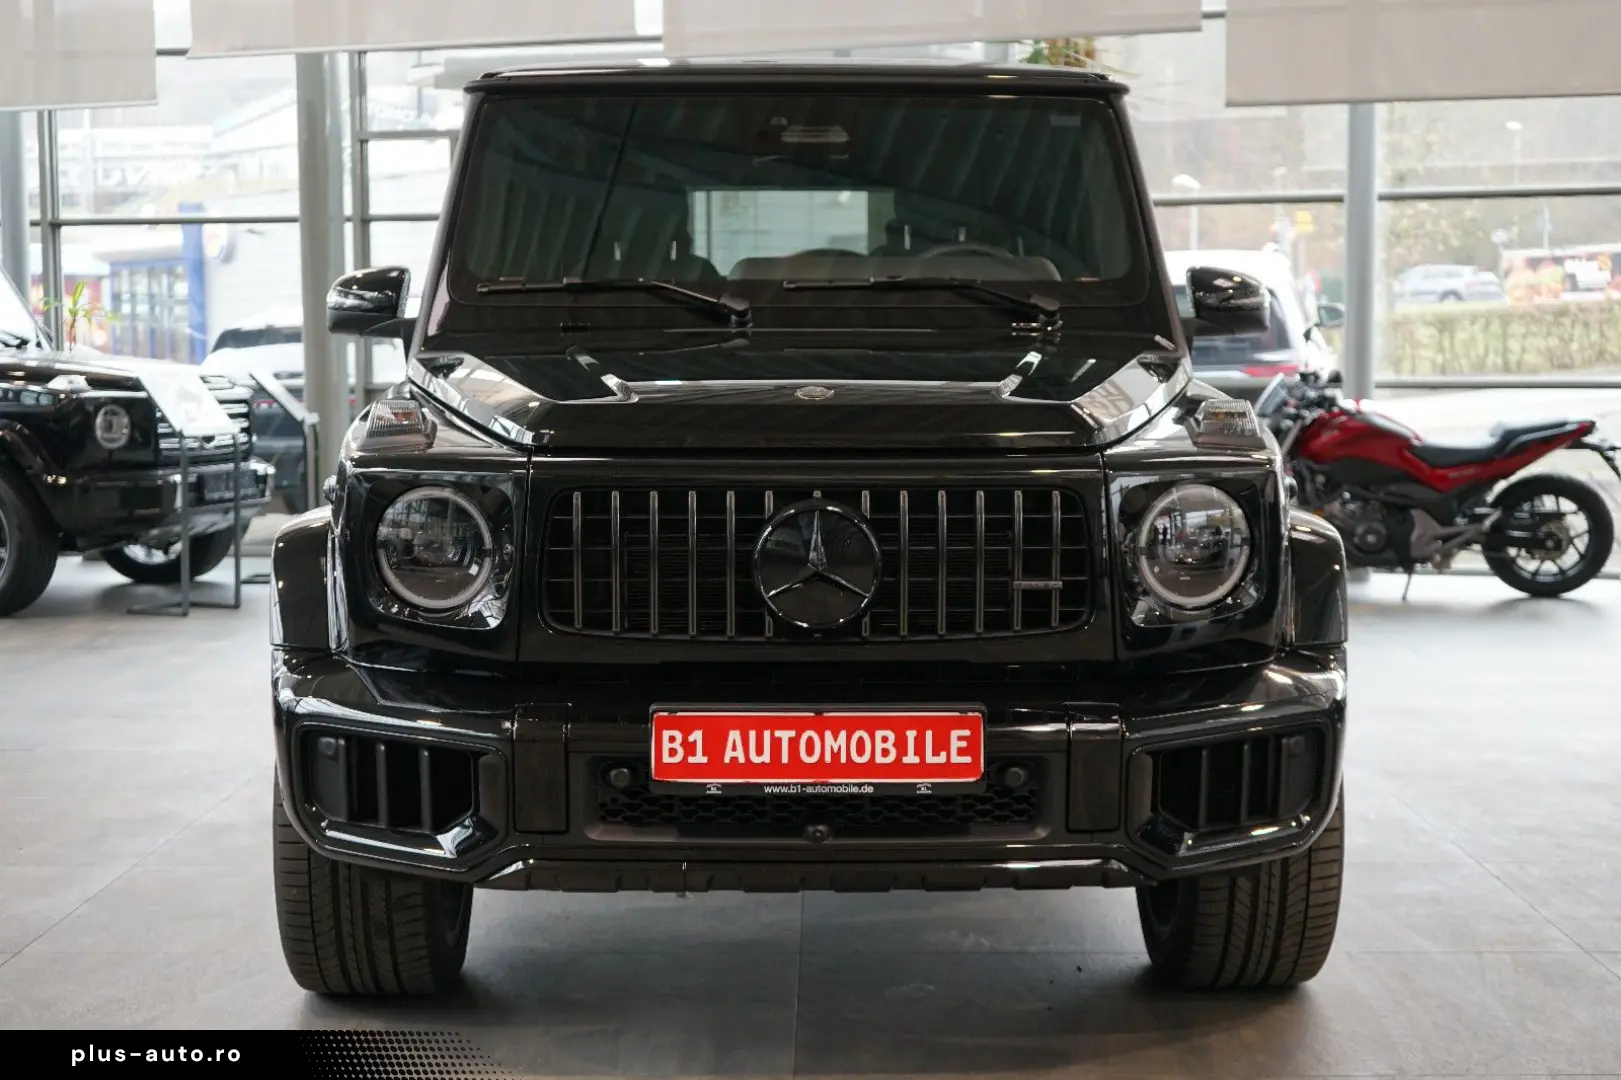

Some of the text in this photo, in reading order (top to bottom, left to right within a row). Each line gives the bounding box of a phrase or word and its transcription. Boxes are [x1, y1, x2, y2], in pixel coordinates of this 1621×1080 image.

[661, 729, 973, 764] B1 AUTOMOBILE
[763, 783, 874, 794] www.b1-automobile.de
